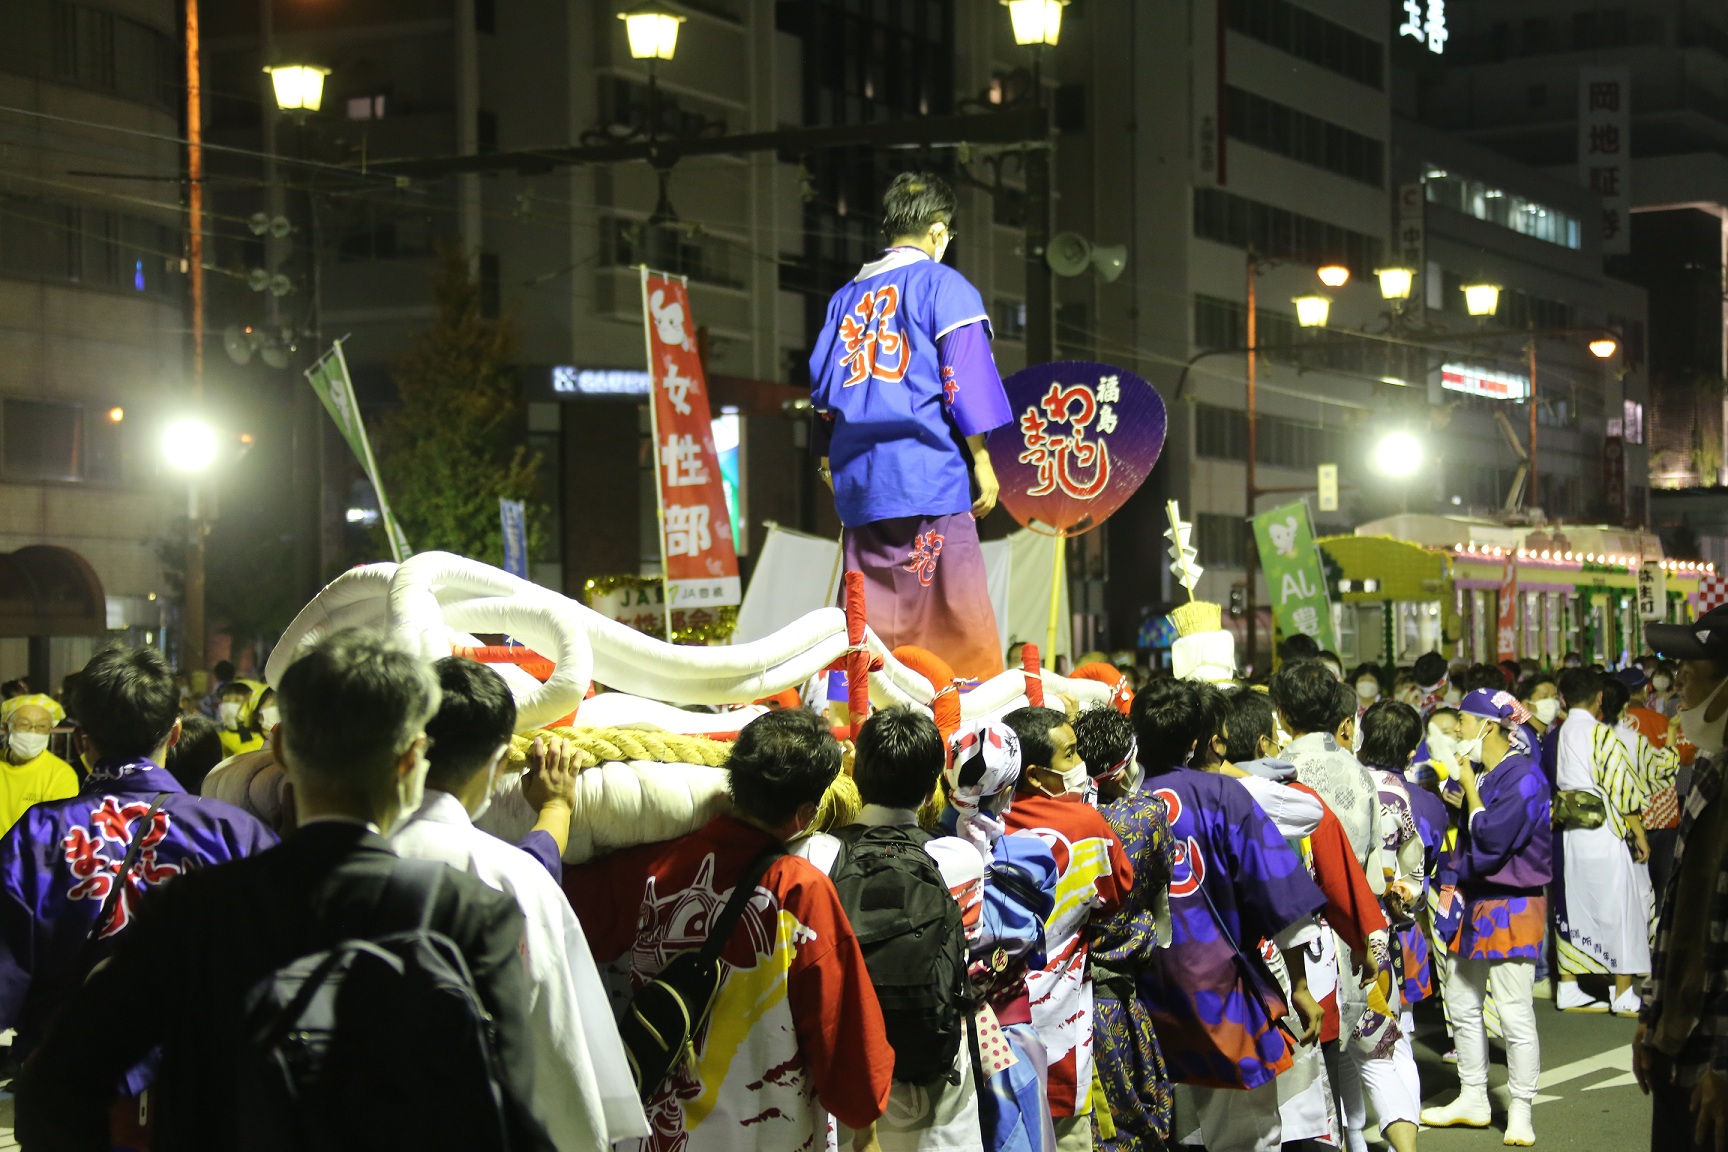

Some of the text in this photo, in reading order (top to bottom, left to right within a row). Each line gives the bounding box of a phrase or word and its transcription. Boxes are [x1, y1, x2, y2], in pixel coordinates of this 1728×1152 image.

[1018, 405, 1056, 496] まつり
[1041, 381, 1110, 499] わらじ
[1096, 374, 1120, 435] 福島
[661, 363, 712, 558] 女性部
